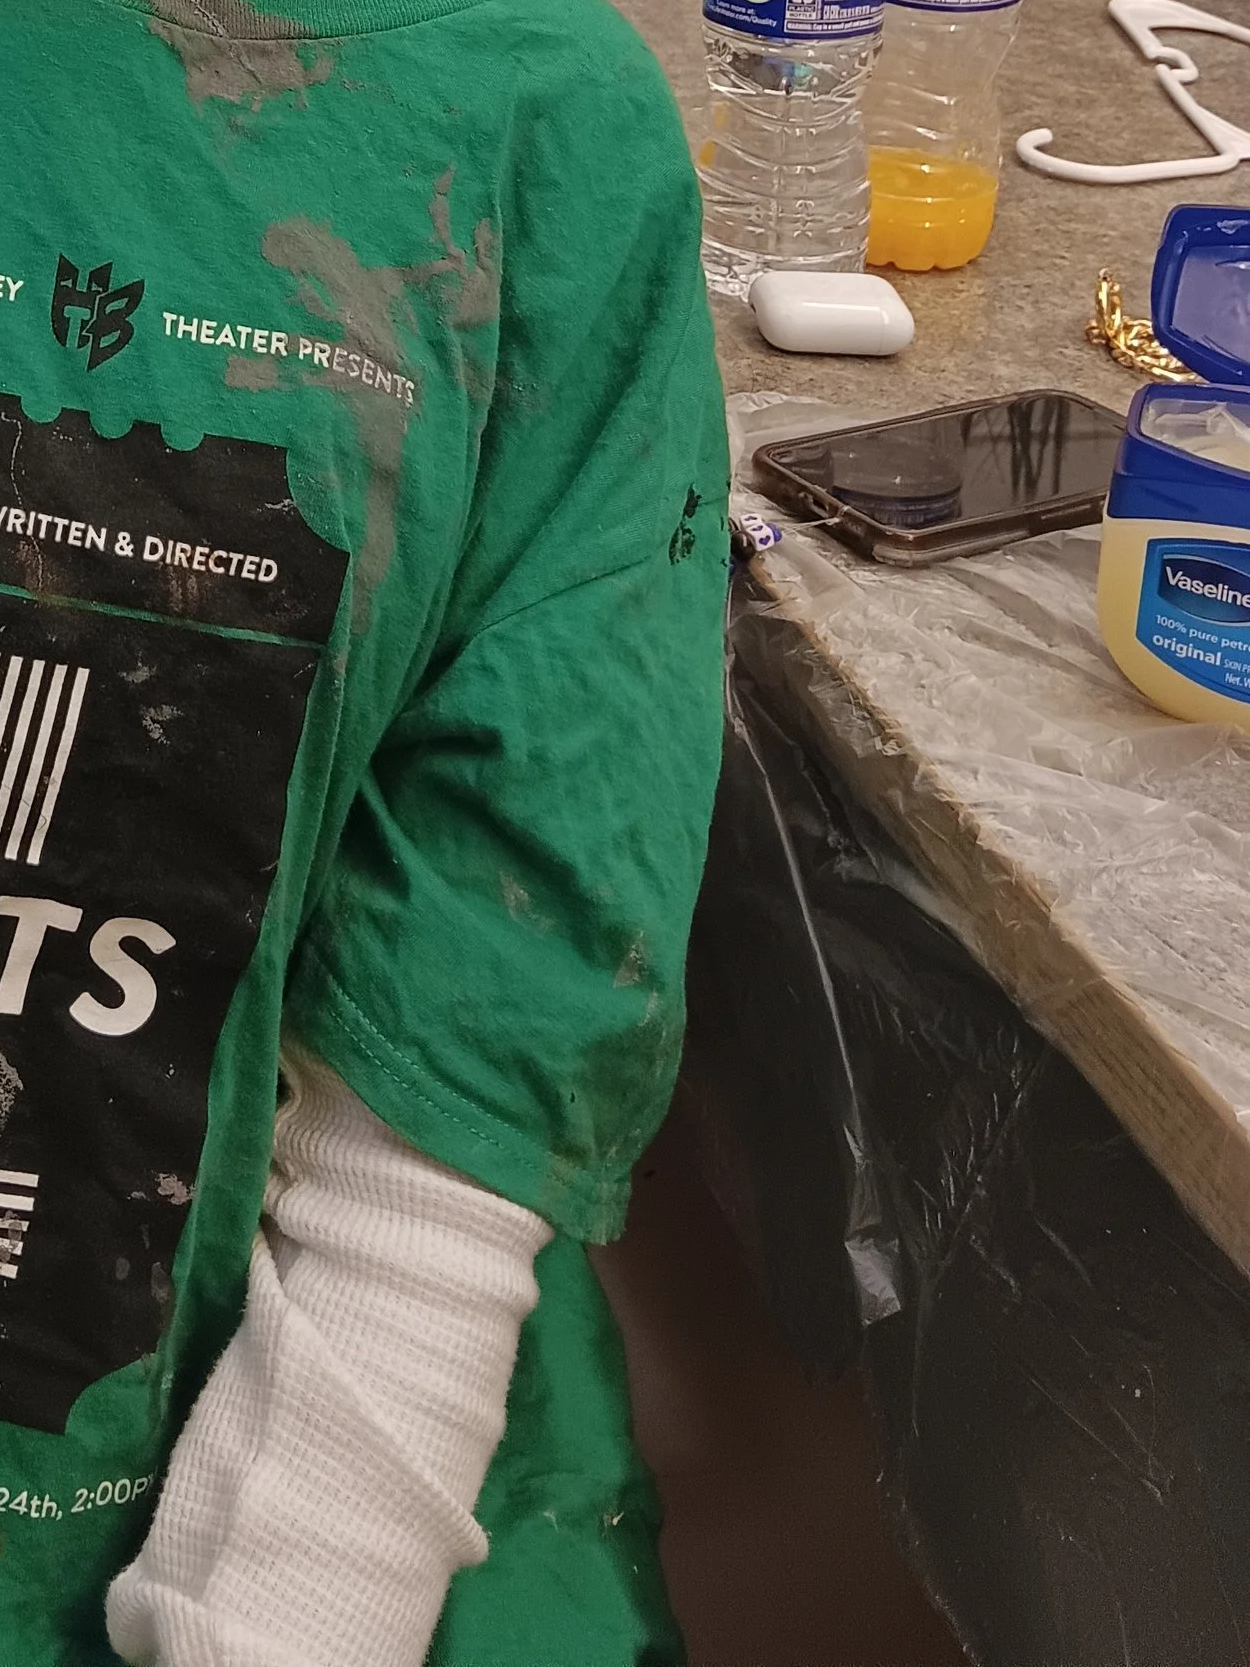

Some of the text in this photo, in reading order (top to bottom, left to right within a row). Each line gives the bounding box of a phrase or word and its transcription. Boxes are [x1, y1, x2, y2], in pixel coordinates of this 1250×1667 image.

[162, 312, 289, 358] THEATER
[299, 337, 415, 407] PRESENTS
[114, 529, 135, 558] &
[144, 536, 278, 583] DIRECTED
[1165, 565, 1250, 608] Vaseline
[1156, 614, 1187, 633] 100%
[1189, 627, 1218, 643] pure
[1152, 634, 1222, 666] original
[70, 1472, 155, 1514] 2:00P
